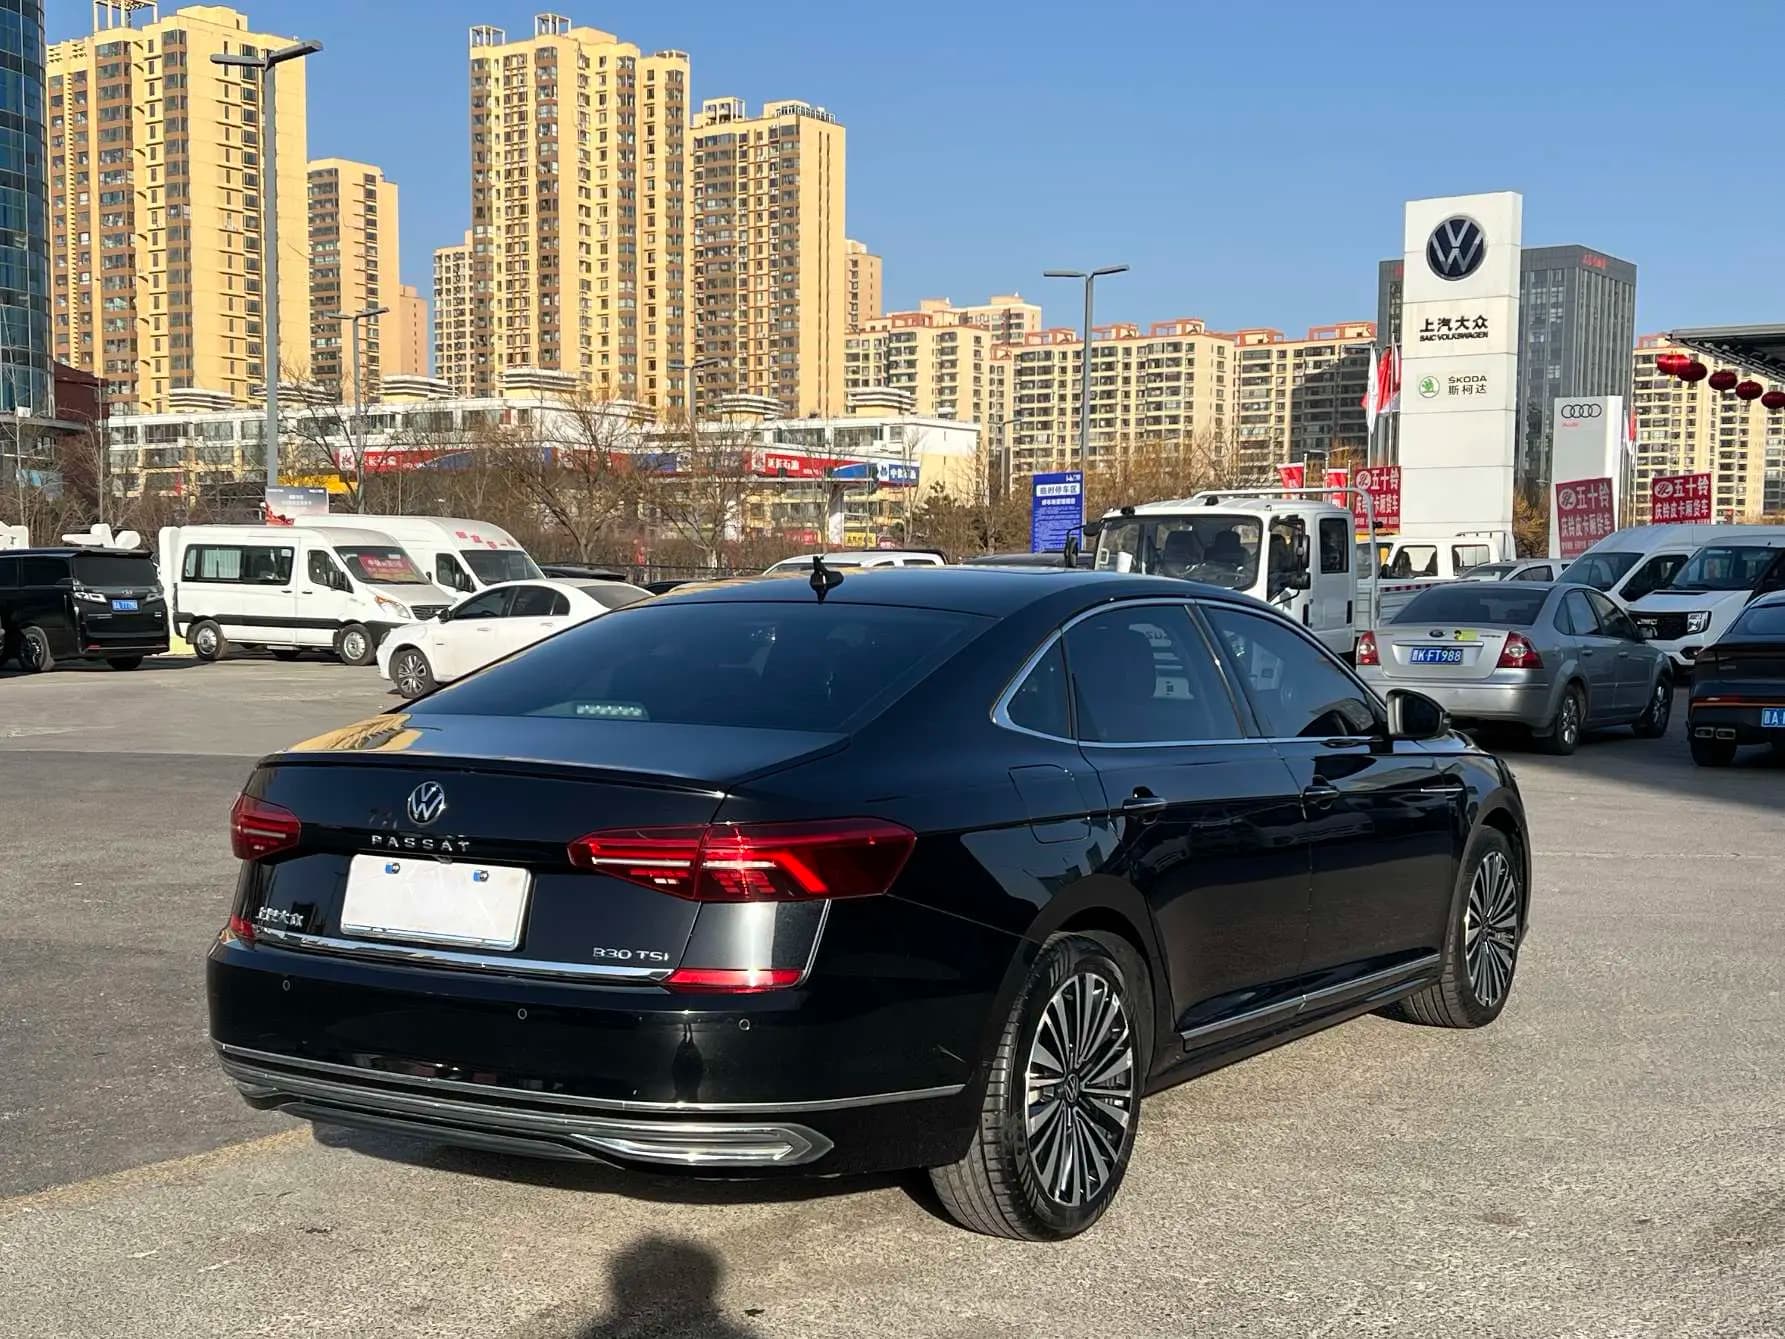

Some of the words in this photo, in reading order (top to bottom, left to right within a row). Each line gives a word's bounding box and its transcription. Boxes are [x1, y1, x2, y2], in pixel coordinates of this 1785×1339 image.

[1420, 315, 1488, 332] 上汽大众
[1438, 332, 1488, 340] VOLKSWAGEN
[1448, 384, 1487, 395] 斯柯达
[1370, 467, 1400, 490] 五十铃
[1673, 477, 1709, 498] 五十铃
[1576, 482, 1610, 509] 五十铃
[1655, 499, 1709, 520] 庆铃皮卡厢货车
[371, 834, 470, 852] PASSAT
[636, 950, 669, 961] TSI
